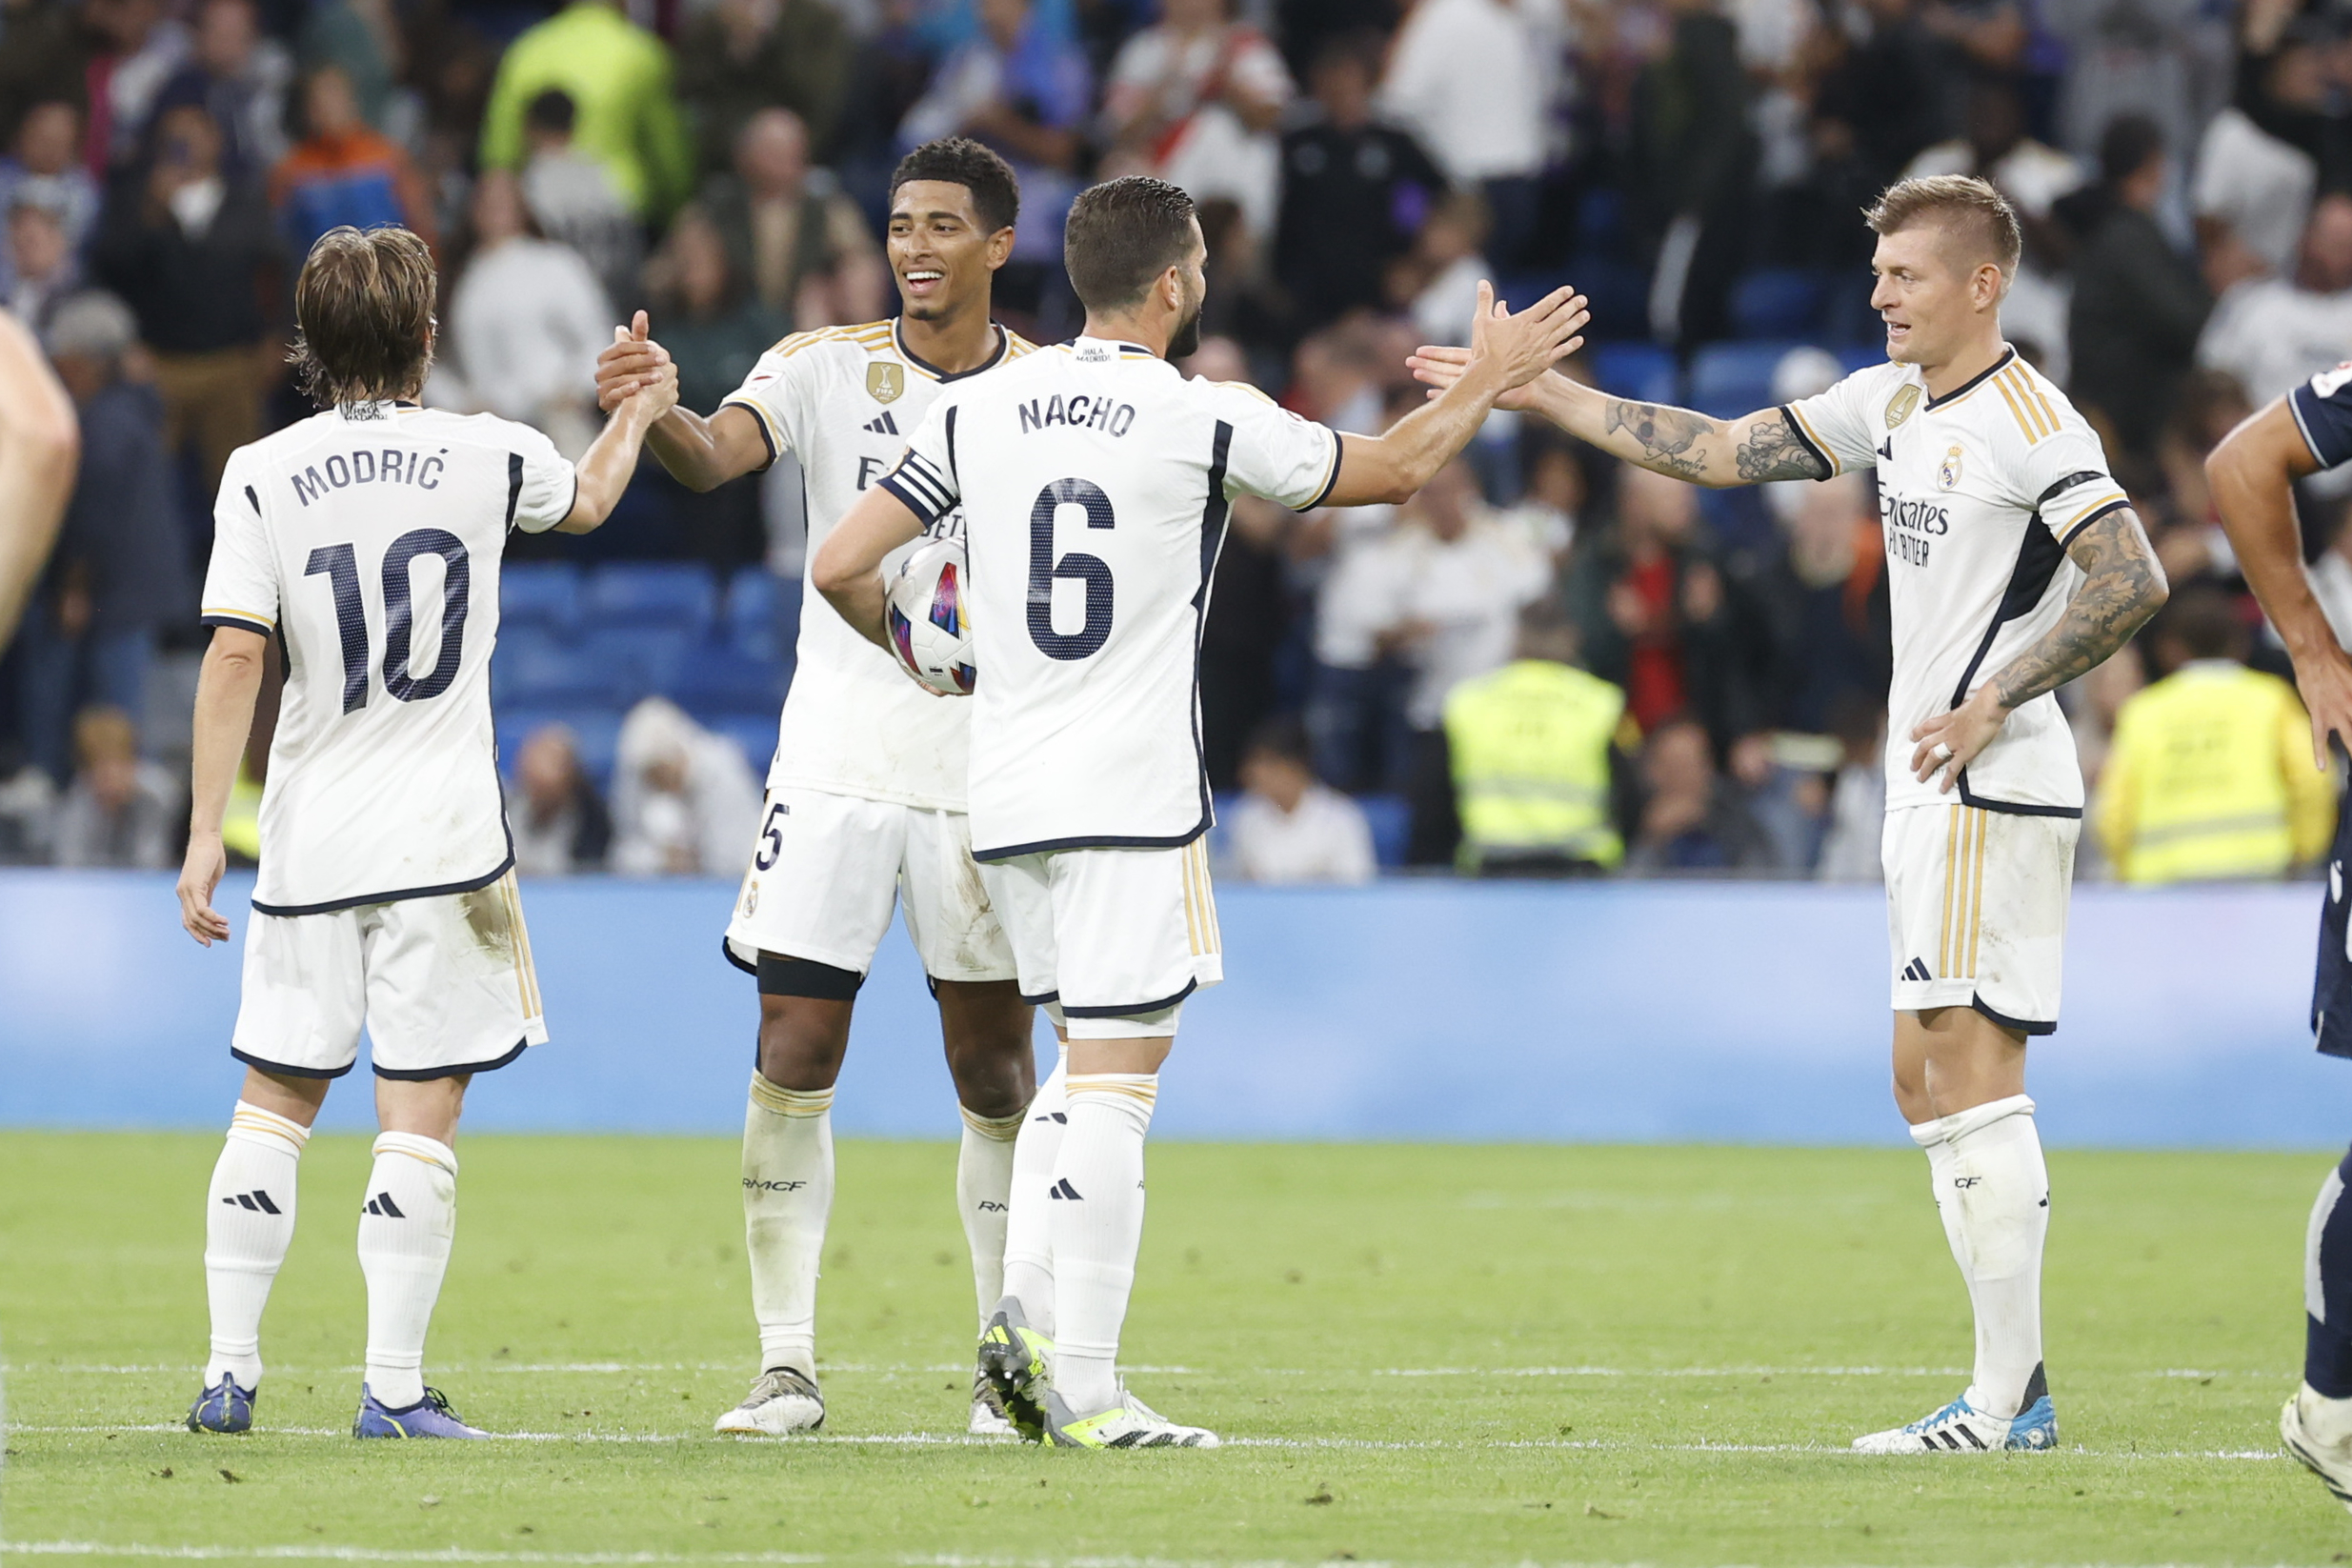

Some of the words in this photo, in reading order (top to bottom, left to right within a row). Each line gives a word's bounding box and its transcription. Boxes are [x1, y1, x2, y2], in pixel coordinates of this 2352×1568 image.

[1017, 393, 1137, 439] NACHO
[291, 447, 449, 508] MODRIĆ
[1027, 476, 1116, 662] 6
[303, 527, 471, 716] 10
[754, 802, 790, 872] 5
[742, 1177, 807, 1192] RMCF
